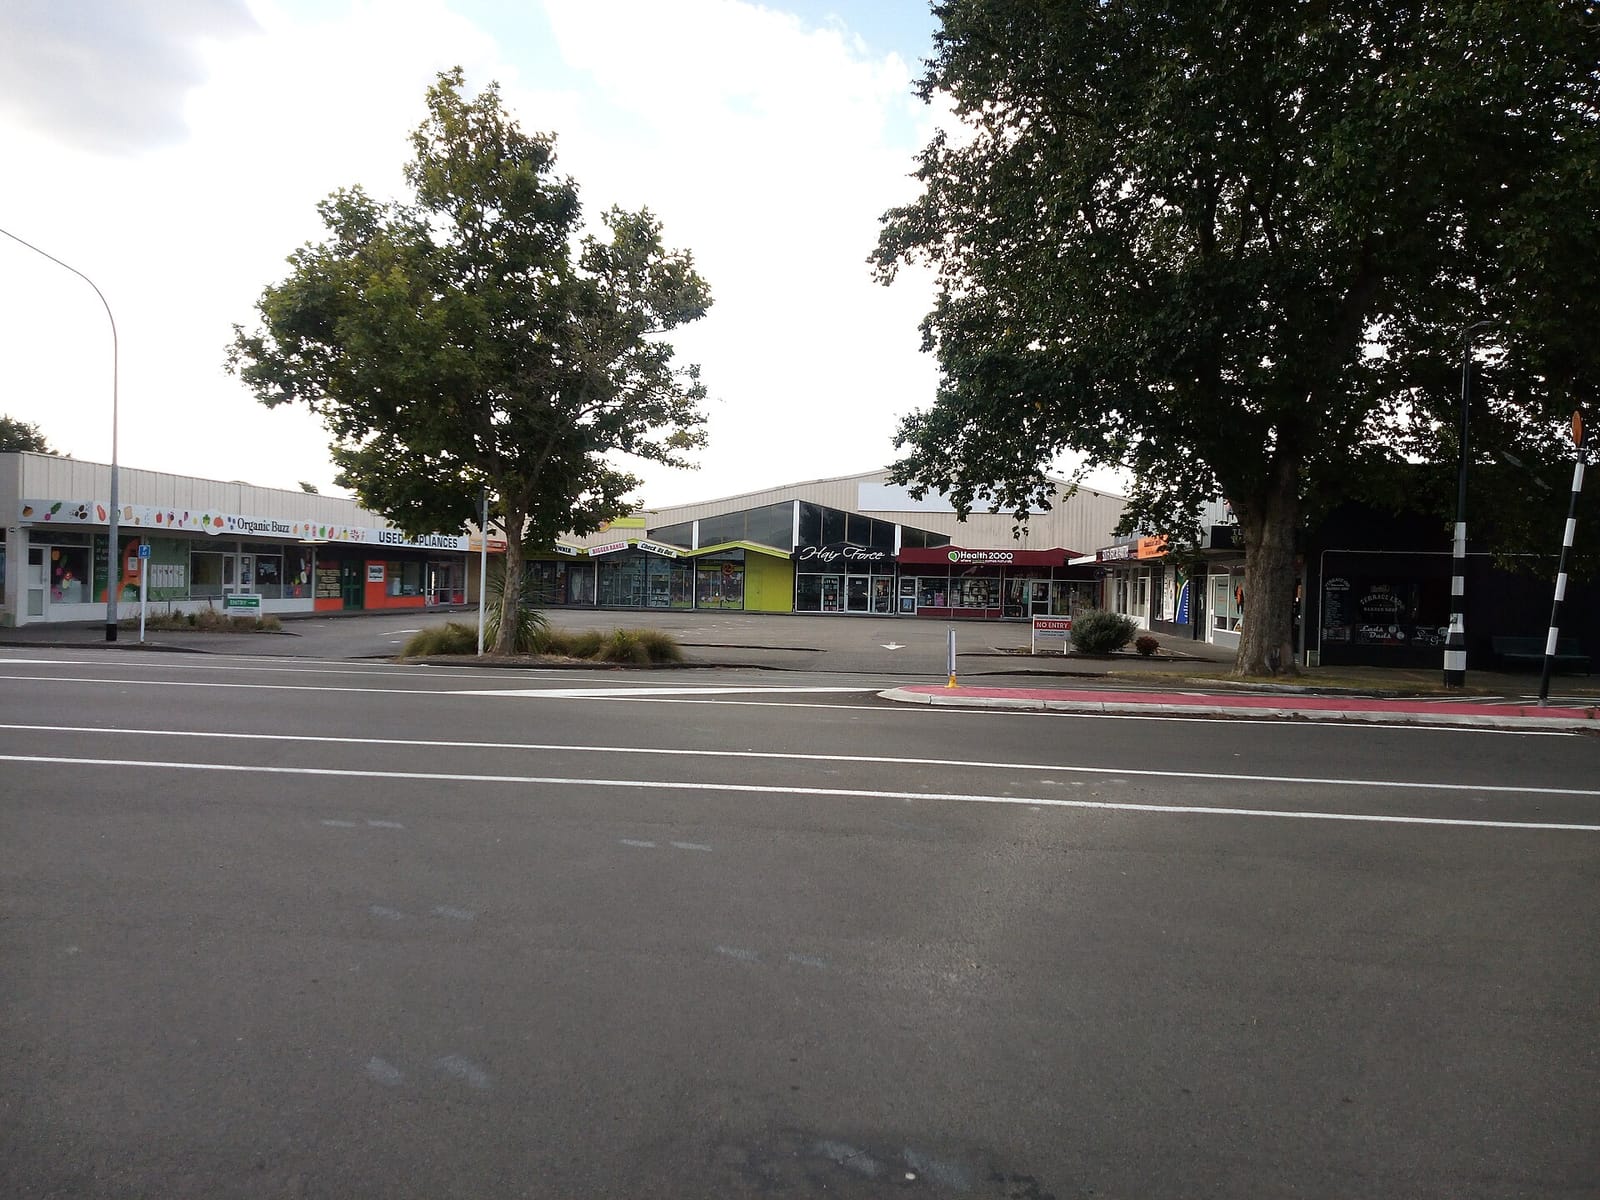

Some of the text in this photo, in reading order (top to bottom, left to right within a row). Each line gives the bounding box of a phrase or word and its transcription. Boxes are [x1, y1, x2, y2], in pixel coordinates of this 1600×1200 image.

[237, 517, 290, 535] Organic Buzz
[378, 531, 458, 549] USED PLIANCES
[592, 542, 625, 555] BIGGER RANGE
[640, 542, 657, 551] Check
[663, 548, 674, 556] Out
[800, 546, 886, 562] Hair Force
[960, 551, 1013, 560] Health 2000
[1048, 621, 1069, 629] ENTRY
